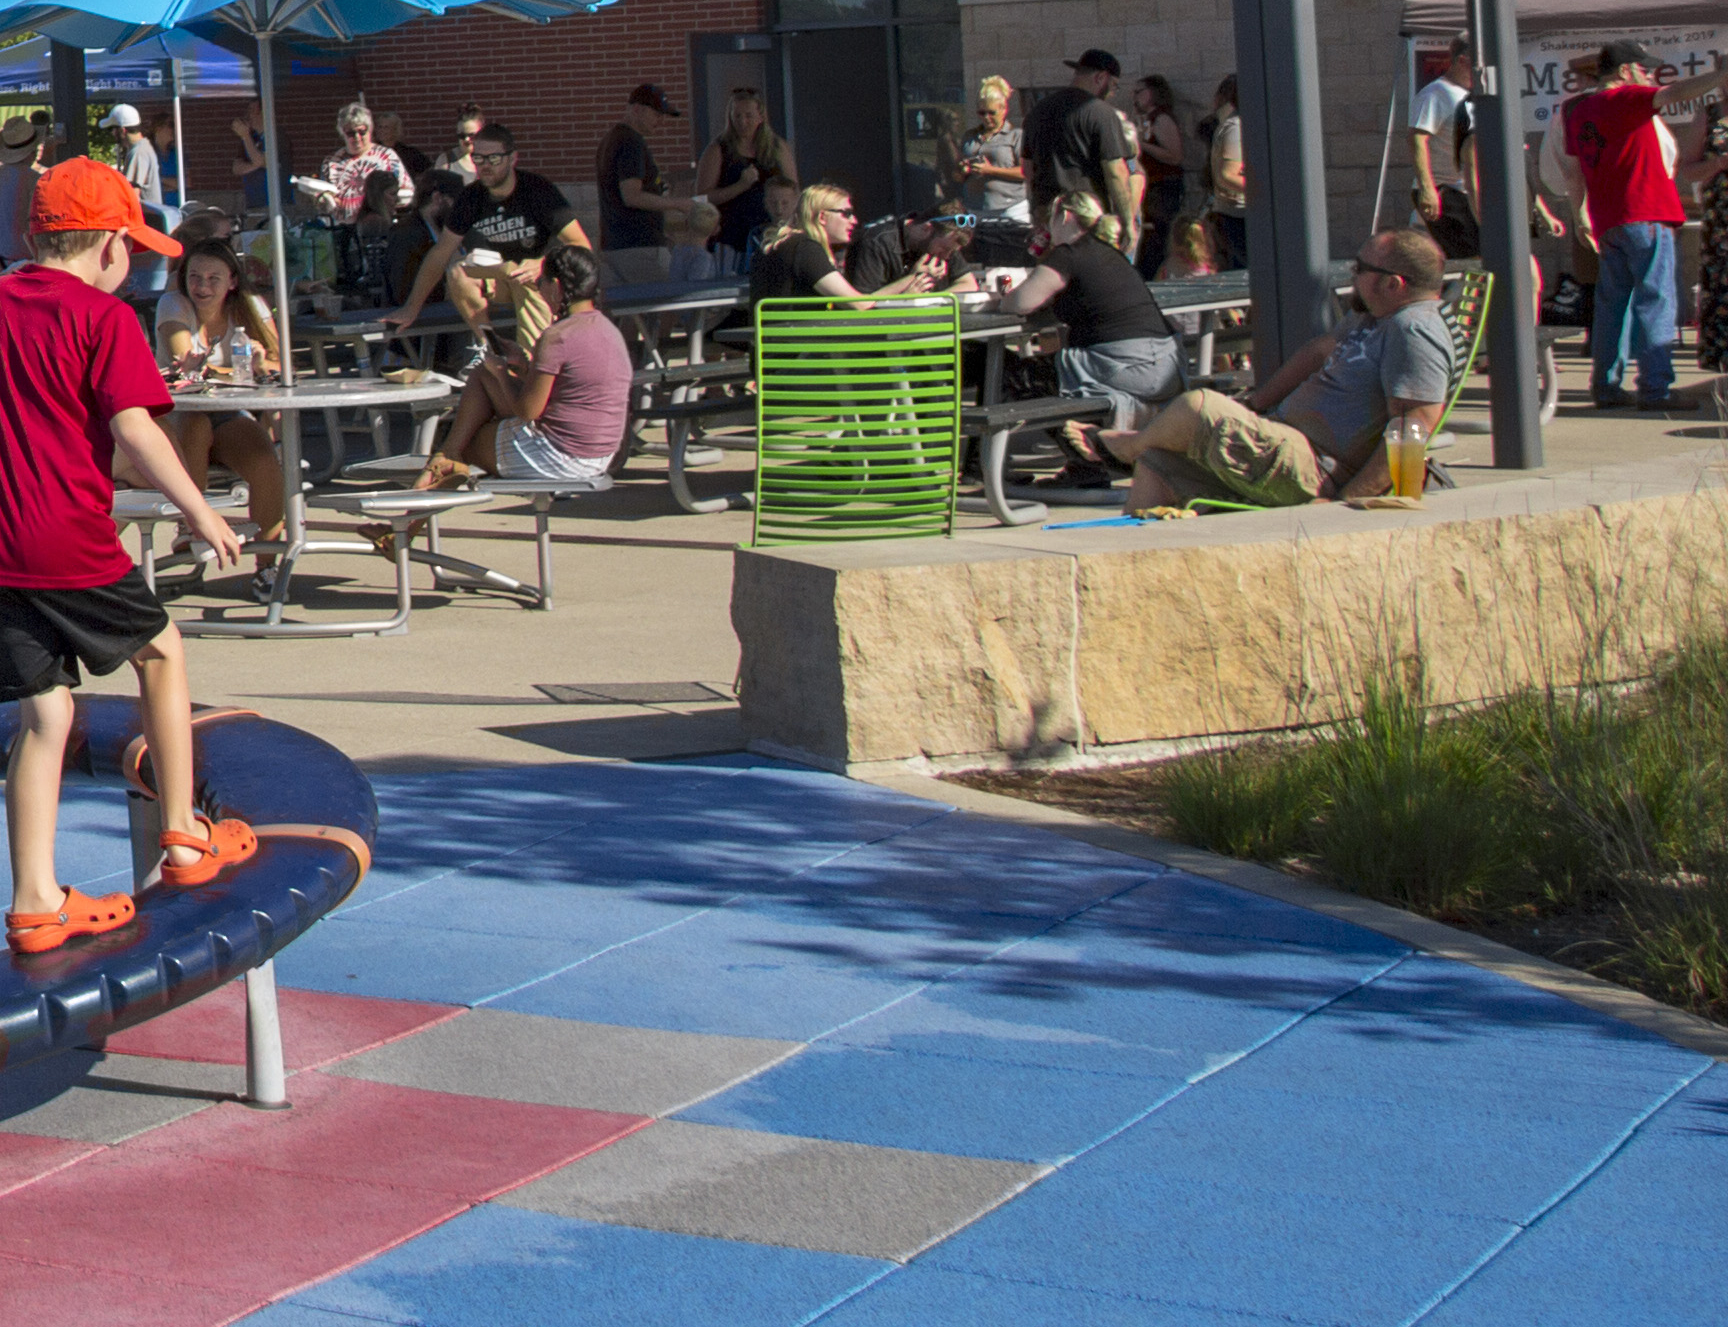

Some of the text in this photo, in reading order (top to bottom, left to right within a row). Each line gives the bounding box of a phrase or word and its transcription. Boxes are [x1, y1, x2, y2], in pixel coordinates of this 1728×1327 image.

[1684, 30, 1716, 42] 2019
[20, 82, 50, 95] Right
[114, 78, 141, 89] here.
[477, 215, 524, 236] OLDEN
